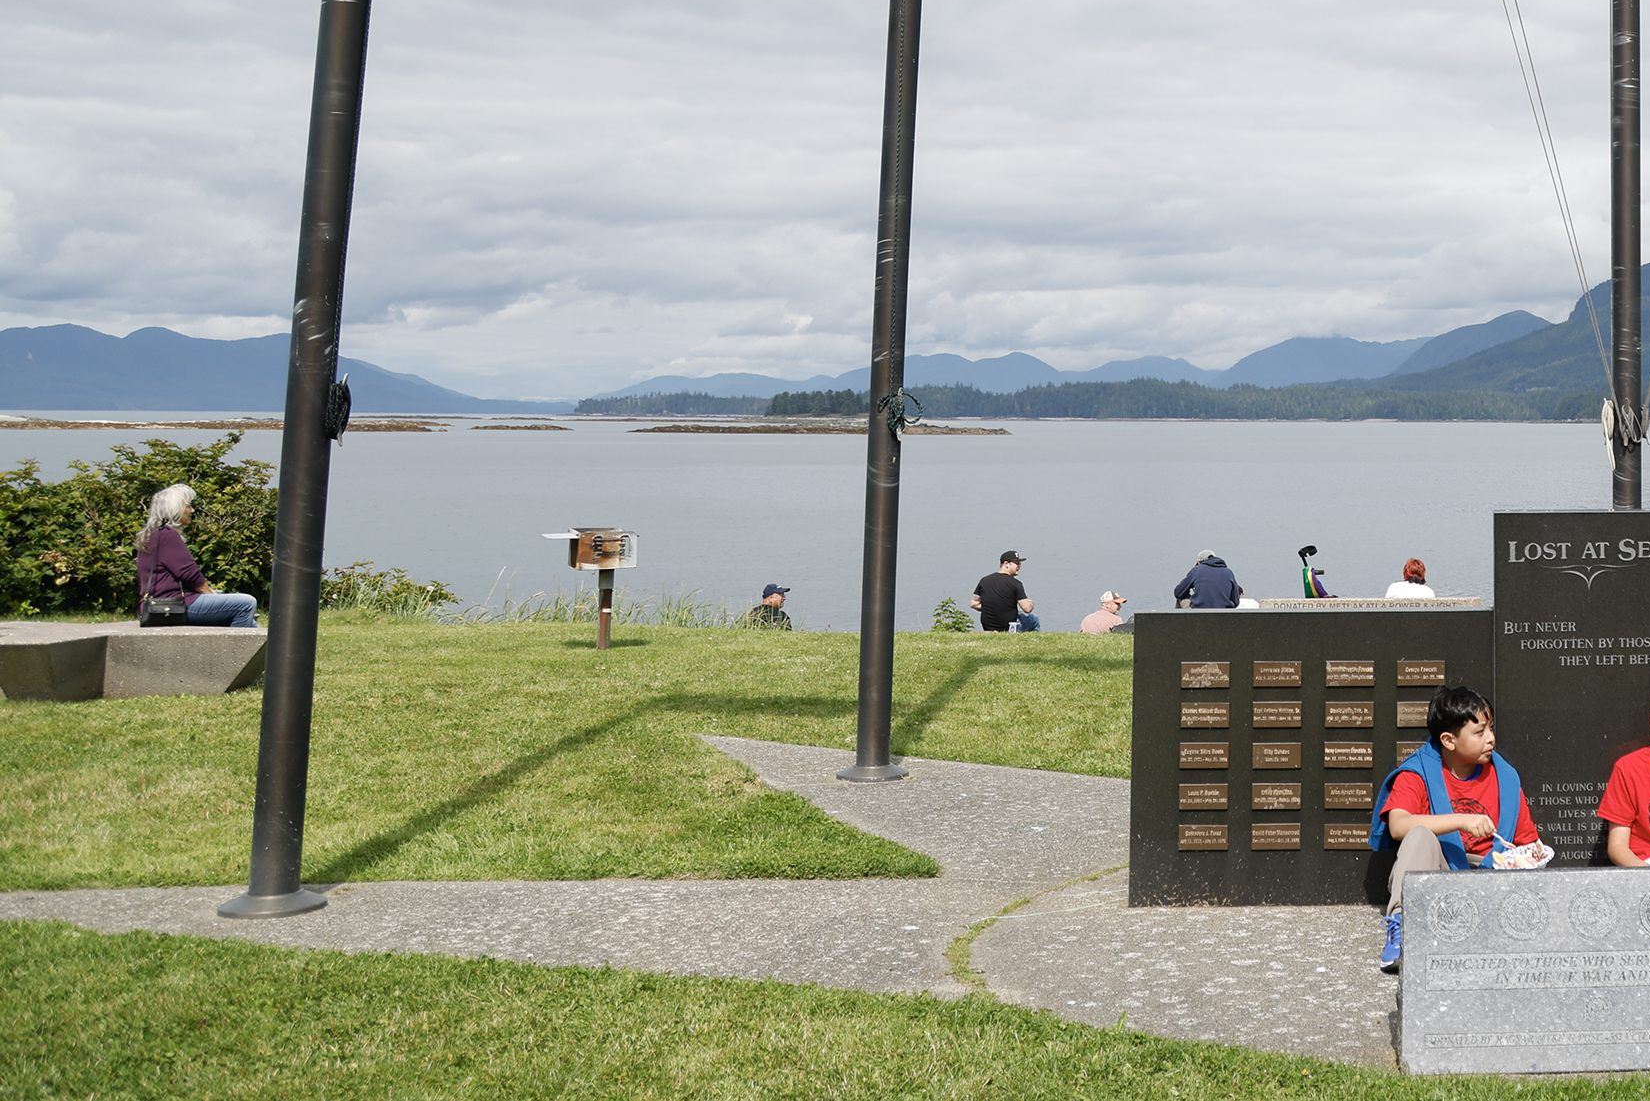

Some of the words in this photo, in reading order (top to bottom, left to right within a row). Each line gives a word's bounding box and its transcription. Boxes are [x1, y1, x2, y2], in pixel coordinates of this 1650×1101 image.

[1508, 541, 1571, 563] LOST
[1582, 542, 1609, 559] AT
[1504, 621, 1530, 634] BUT
[1536, 621, 1576, 633] NEVER
[1520, 638, 1594, 650] FORGOTTEN
[1598, 638, 1614, 648] BY
[1559, 656, 1591, 666] THEY
[1596, 655, 1625, 665] LEFT
[1542, 784, 1553, 792] IN
[1557, 782, 1593, 792] LOVING
[1540, 796, 1572, 806] THOSE
[1575, 795, 1599, 805] WHO
[1558, 810, 1586, 818] LIVES
[1547, 822, 1574, 832] WALL
[1577, 822, 1587, 831] IS
[1553, 836, 1583, 845] THEIR
[1560, 851, 1599, 860] AUGUST
[1429, 958, 1507, 971] DEDICATED
[1512, 957, 1530, 969] TO
[1534, 956, 1578, 968] THOSE
[1582, 955, 1615, 967] WHO
[1495, 973, 1510, 984] IN
[1517, 972, 1552, 983] TIME
[1557, 972, 1577, 983] OF
[1582, 971, 1616, 982] WAR
[1618, 970, 1648, 981] AND
